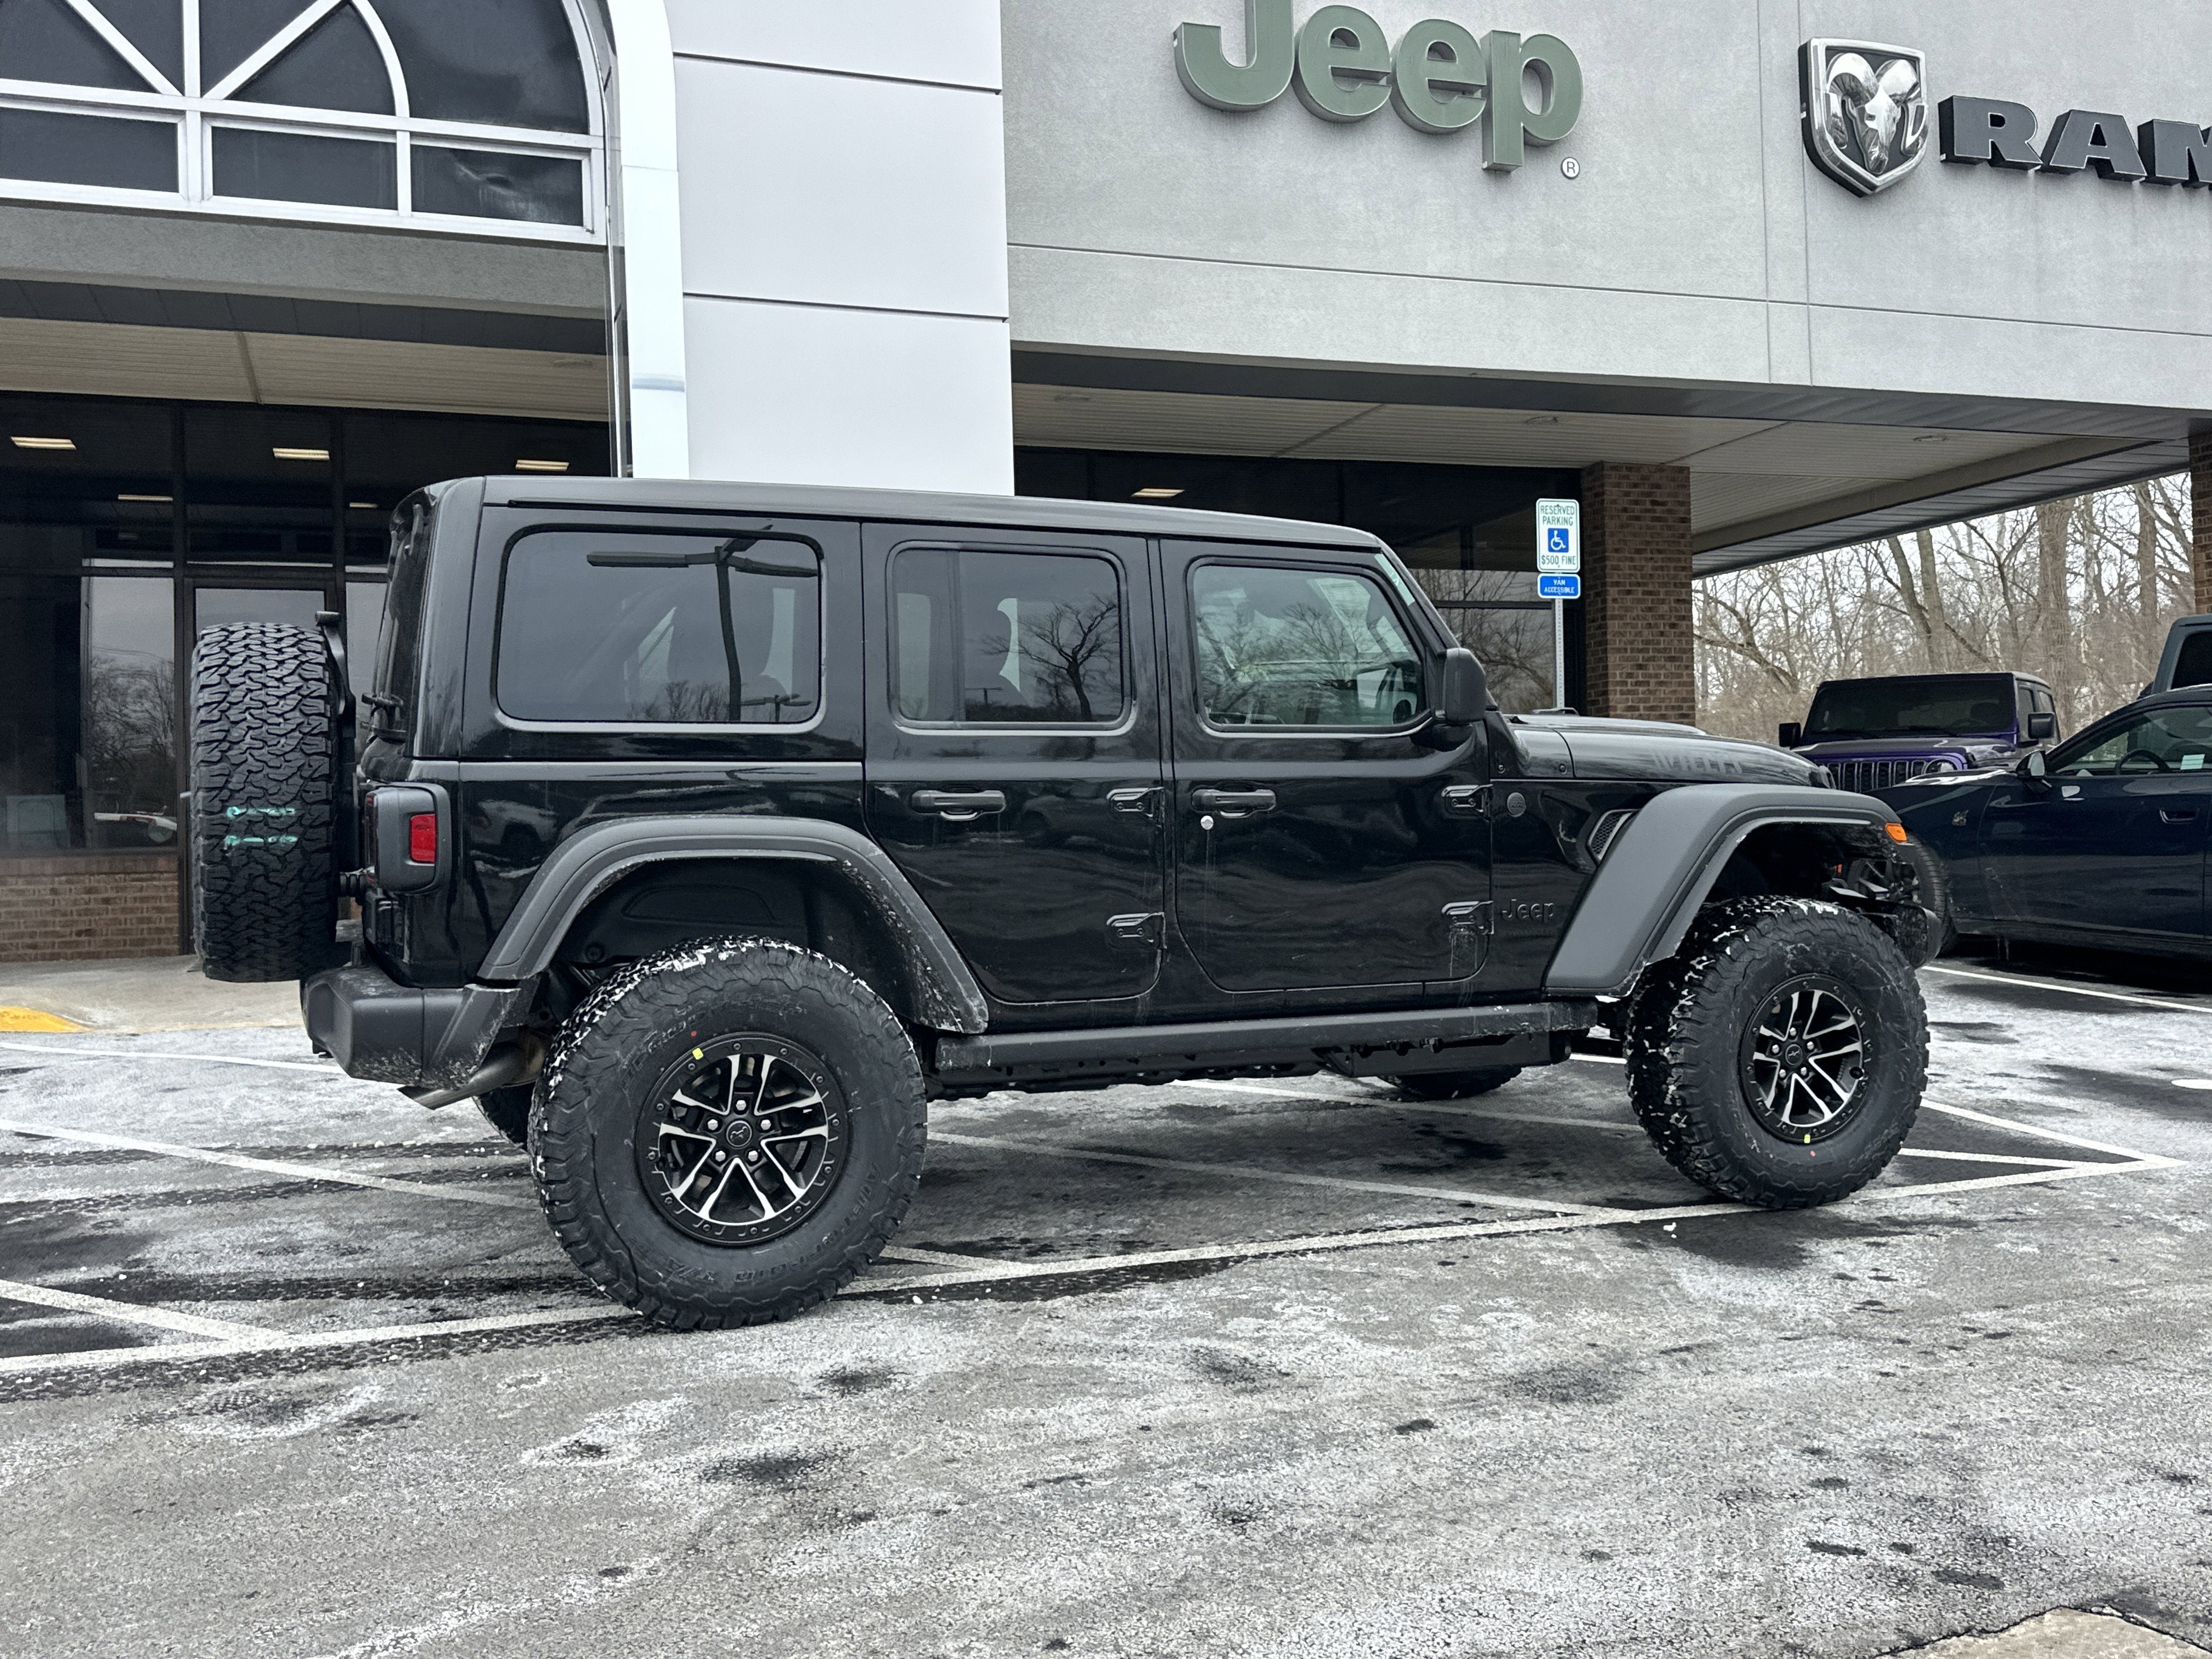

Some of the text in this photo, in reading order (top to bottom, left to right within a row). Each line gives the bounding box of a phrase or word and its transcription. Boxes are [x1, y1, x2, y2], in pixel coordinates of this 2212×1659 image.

[1173, 0, 1583, 172] Jeep
[1541, 505, 1575, 515] RESERVED
[1542, 516, 1573, 526] PARKING
[1541, 555, 1576, 565] $500 FINE
[1501, 899, 1555, 924] Jeep
